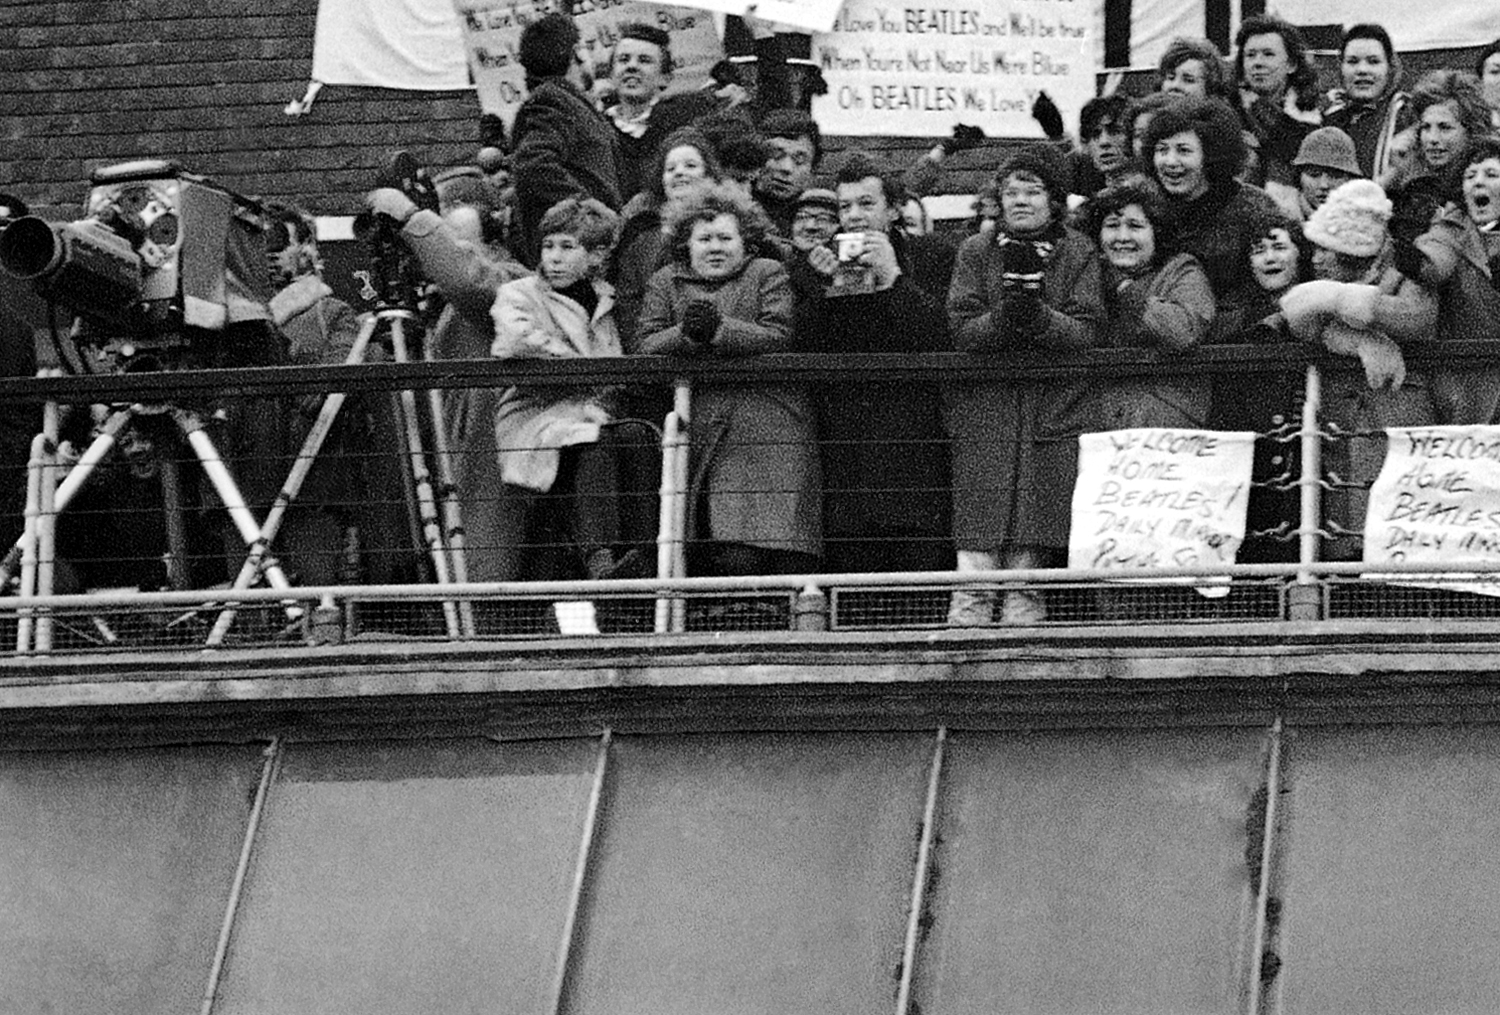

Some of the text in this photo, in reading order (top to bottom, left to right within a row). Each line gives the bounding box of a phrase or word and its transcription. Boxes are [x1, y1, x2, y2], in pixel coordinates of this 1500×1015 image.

[844, 7, 875, 33] Love
[875, 7, 902, 33] You
[904, 8, 979, 36] BEATLES
[983, 18, 1008, 36] and
[1039, 17, 1056, 37] be
[1058, 19, 1086, 38] true
[818, 46, 861, 71] When
[907, 49, 931, 72] Not
[935, 49, 967, 74] Near
[970, 51, 990, 75] Us
[1032, 51, 1070, 76] Blue
[838, 85, 864, 110] Oh
[872, 85, 957, 111] BEATLES
[962, 87, 986, 112] We
[990, 87, 1026, 112] Love
[1110, 432, 1219, 458] WELCOME
[1108, 455, 1183, 480] HOME
[1397, 461, 1474, 494] HOME
[1095, 510, 1163, 537] DAILY
[1386, 526, 1448, 551] DAILY
